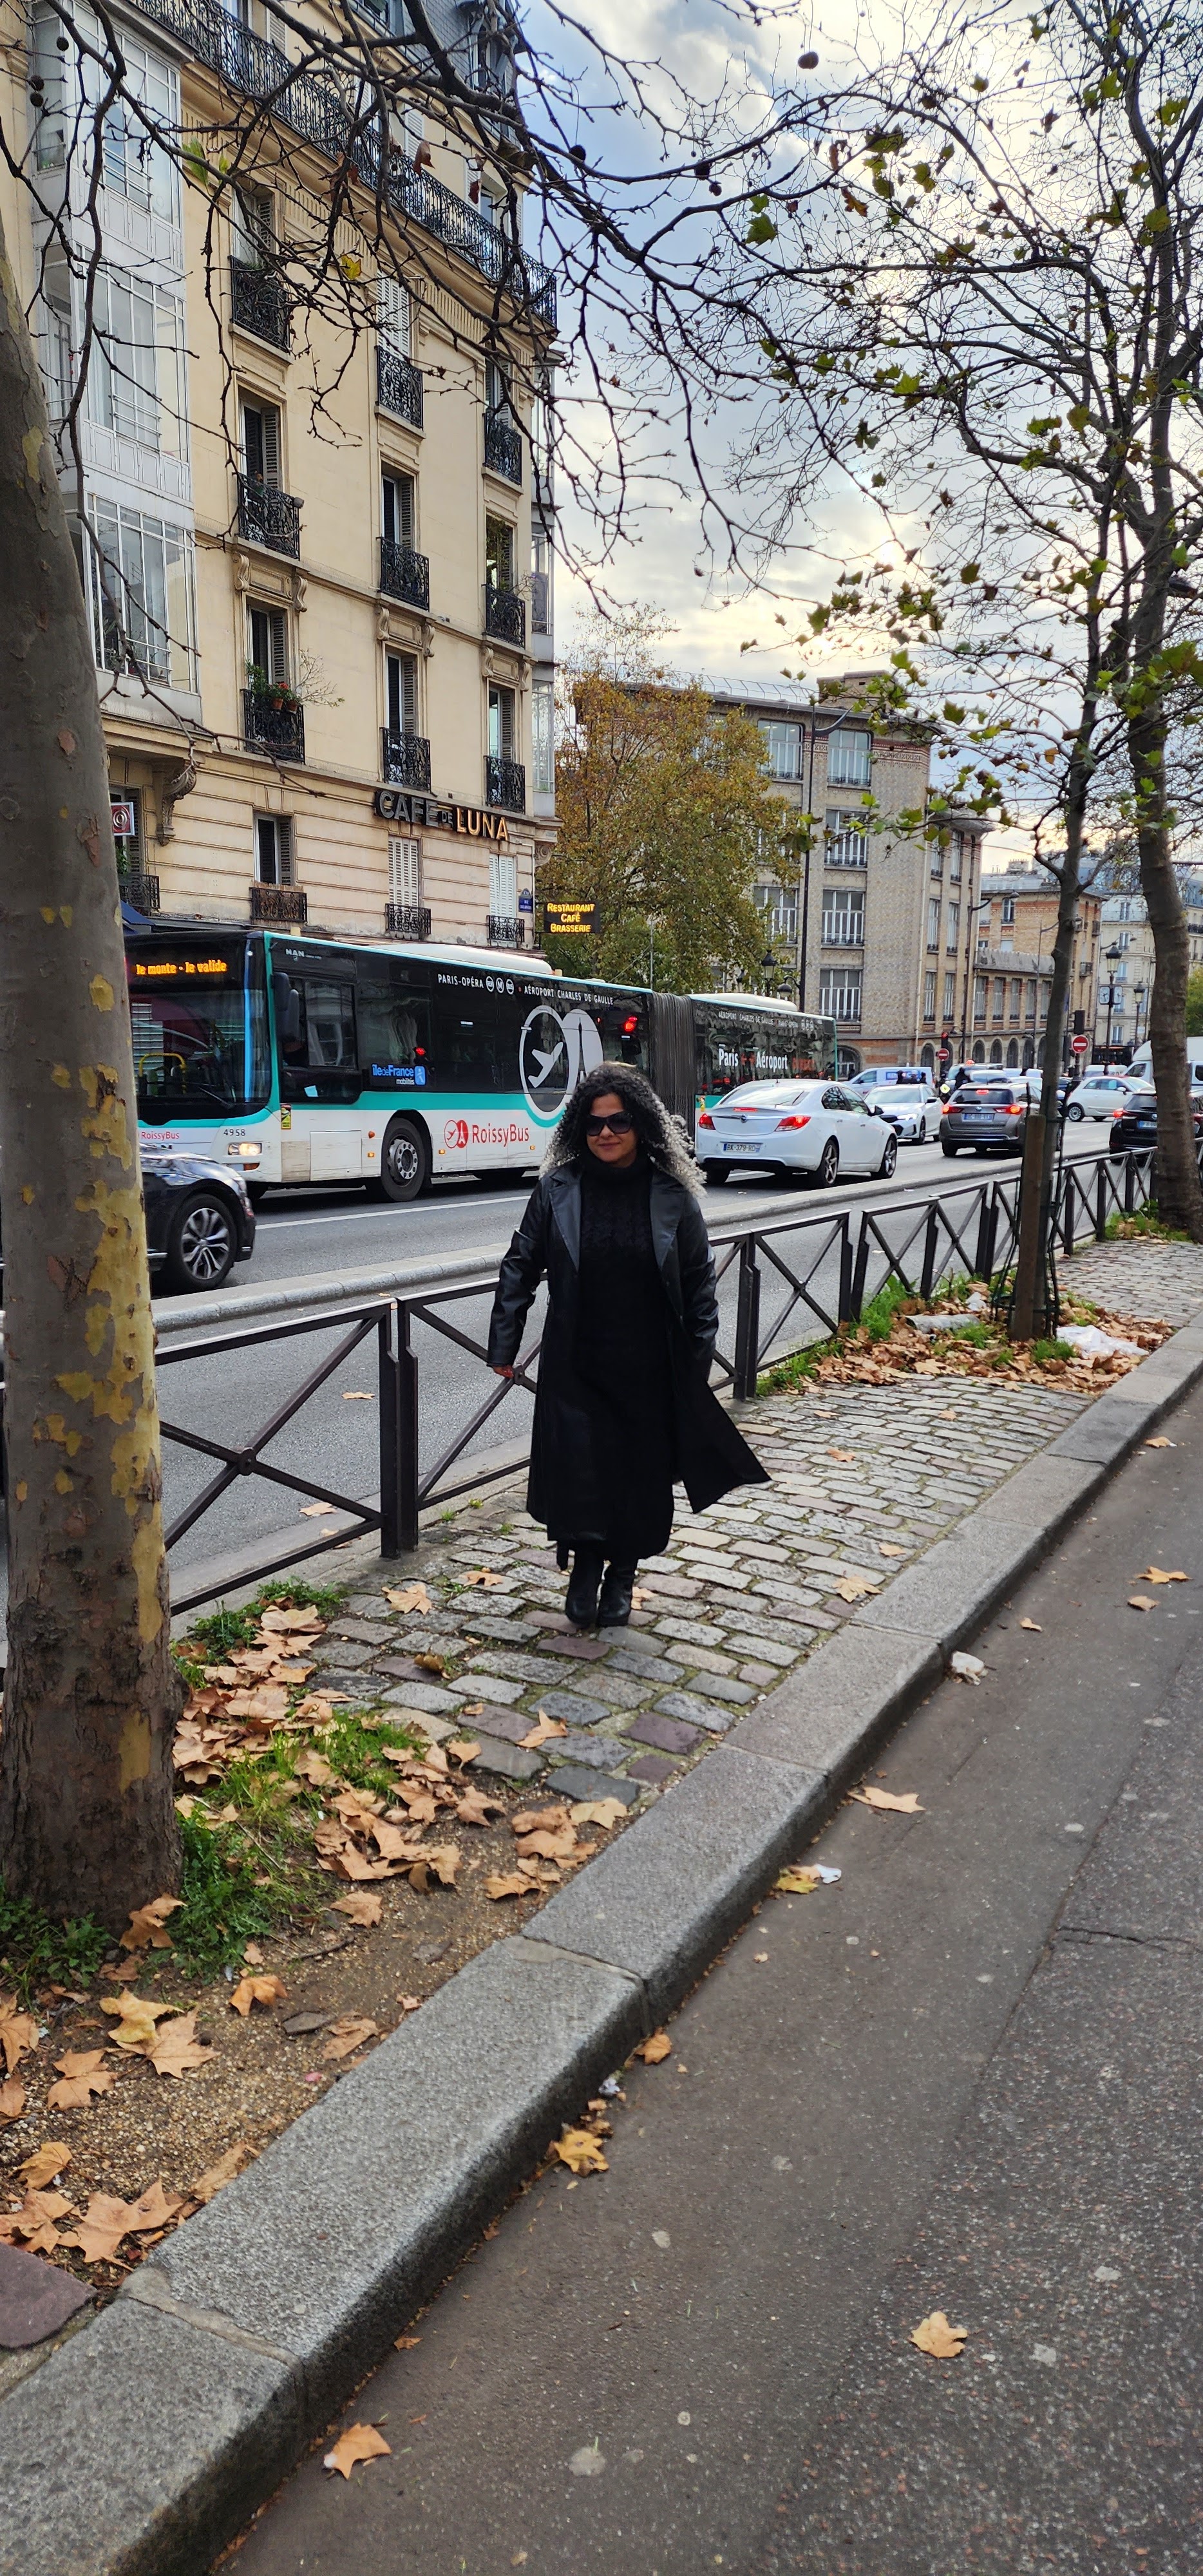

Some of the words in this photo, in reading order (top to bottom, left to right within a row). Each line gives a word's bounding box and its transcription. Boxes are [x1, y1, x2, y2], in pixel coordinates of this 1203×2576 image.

[442, 811, 453, 824] DE
[457, 807, 509, 841] LUNA
[547, 903, 595, 912] RESTAURANT
[550, 923, 591, 933] BRASSERIE
[285, 948, 305, 957] MAN
[147, 963, 177, 974] monte
[197, 960, 227, 972] valide
[438, 974, 484, 989] PARIS-OPÉRA
[524, 984, 554, 998] AÉROPORT
[557, 990, 582, 1001] CHARLES
[584, 993, 592, 1002] DE
[594, 995, 614, 1005] GAULLE
[718, 1048, 739, 1067] Paris
[755, 1050, 788, 1072] Aéroport
[141, 1131, 180, 1141] RoissyBus
[223, 1128, 246, 1137] 4958
[472, 1123, 529, 1147] RoissyBus
